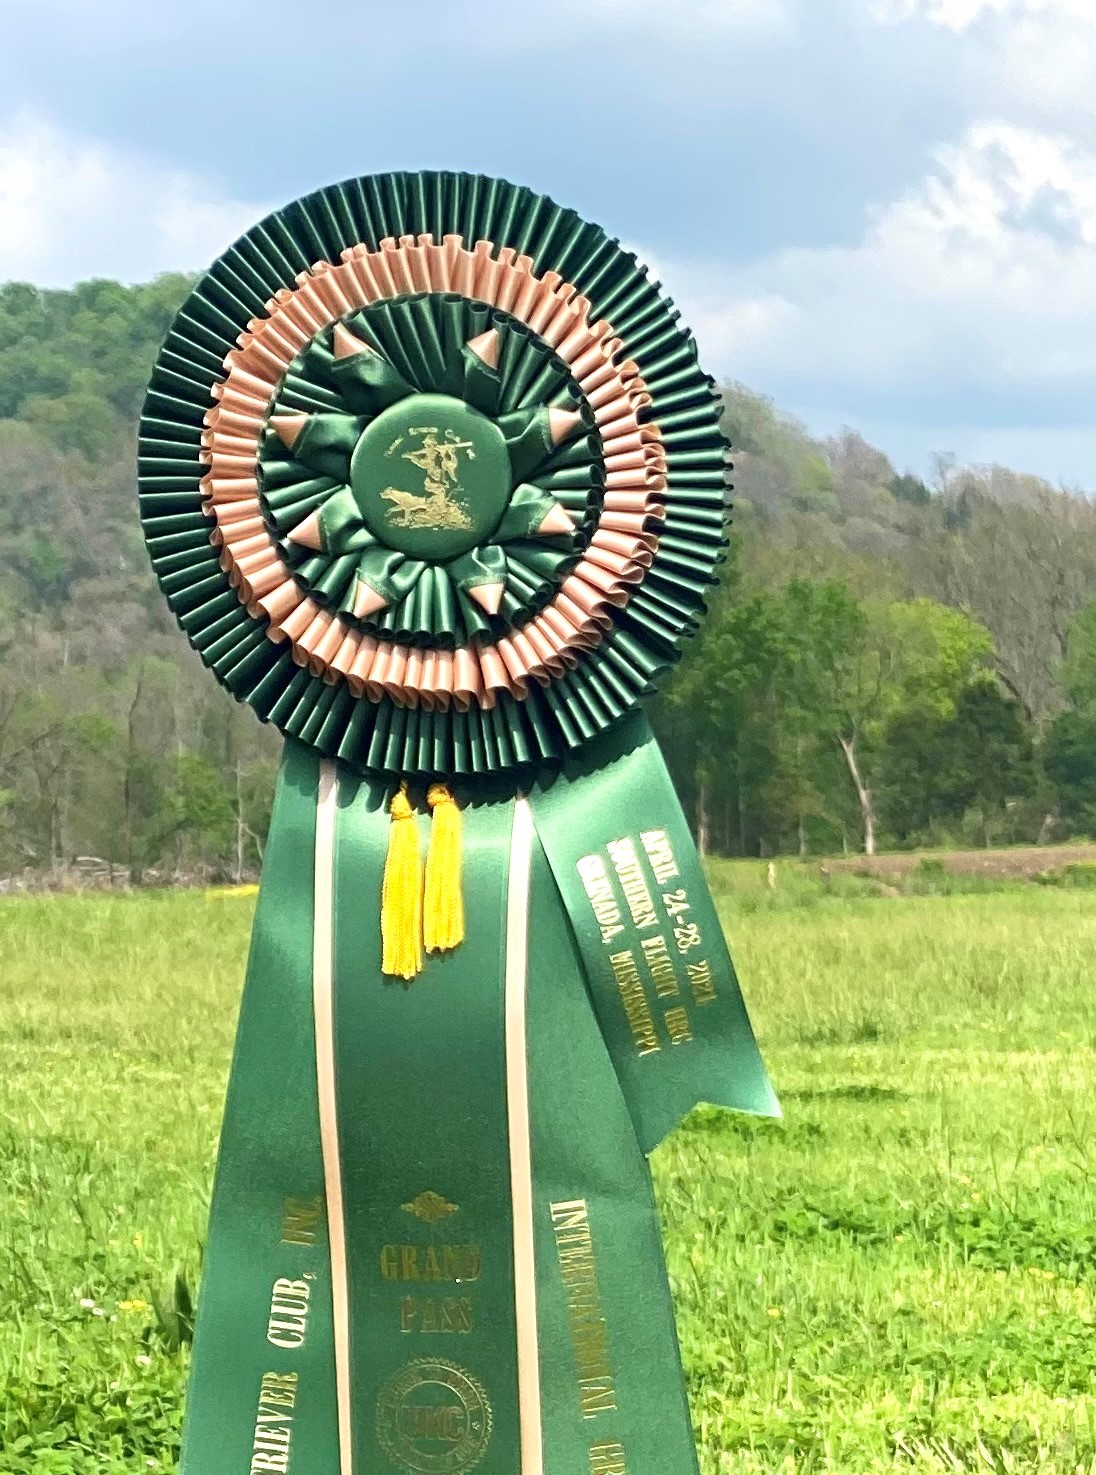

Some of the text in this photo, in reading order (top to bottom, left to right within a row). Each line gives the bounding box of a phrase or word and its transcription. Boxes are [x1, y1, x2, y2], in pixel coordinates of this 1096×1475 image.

[640, 830, 680, 884] APRIL
[608, 950, 661, 1057] MISSISSIPPI
[380, 1244, 481, 1283] GRAND
[267, 1271, 317, 1349] CLUB,
[400, 1297, 475, 1334] PASS
